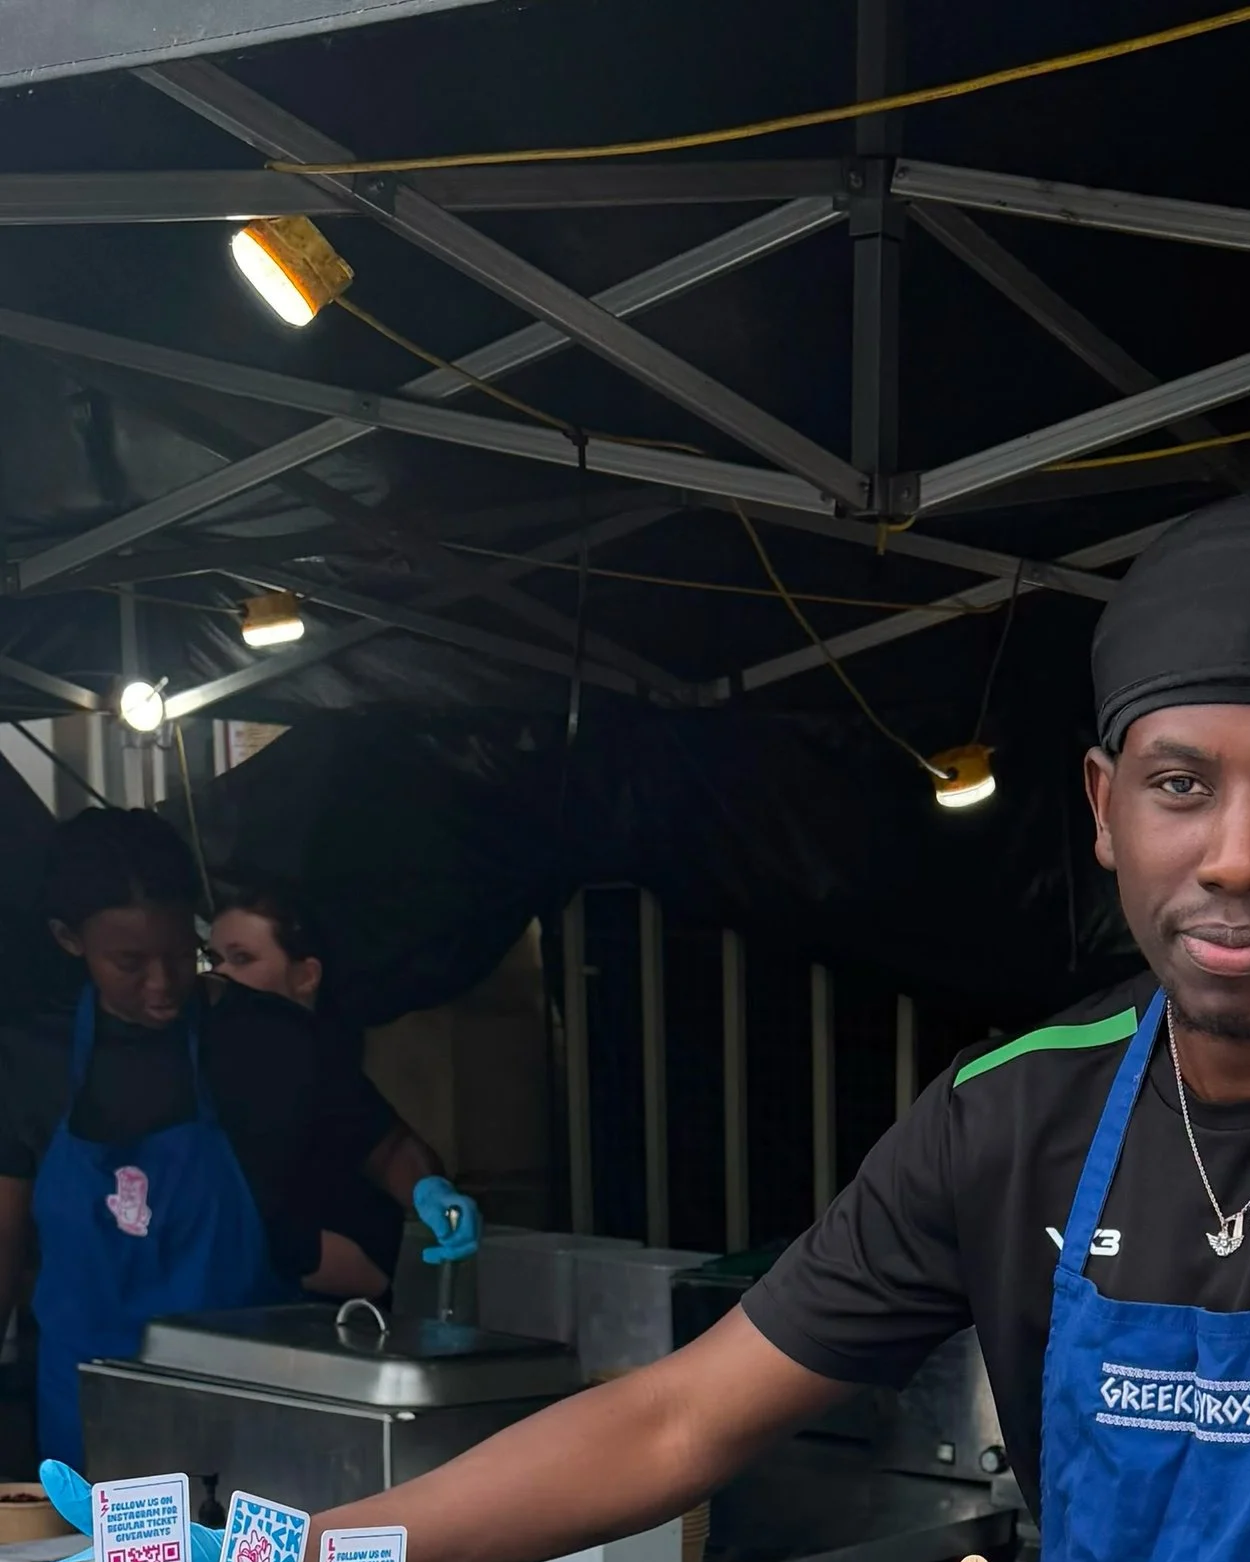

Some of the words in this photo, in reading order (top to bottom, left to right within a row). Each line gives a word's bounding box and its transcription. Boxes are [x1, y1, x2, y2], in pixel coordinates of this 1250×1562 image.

[111, 1499, 146, 1512] FOLLOW
[148, 1498, 158, 1506] US
[160, 1495, 173, 1504] ON
[107, 1507, 160, 1522] INSTAGRAM
[162, 1506, 177, 1516] FOR
[107, 1520, 145, 1533] REGULAR
[146, 1516, 178, 1527] TICKET
[116, 1527, 171, 1542] GIVEAWAYS
[336, 1551, 367, 1561] FOLLOW
[369, 1550, 379, 1558] US
[380, 1549, 391, 1558] ON
